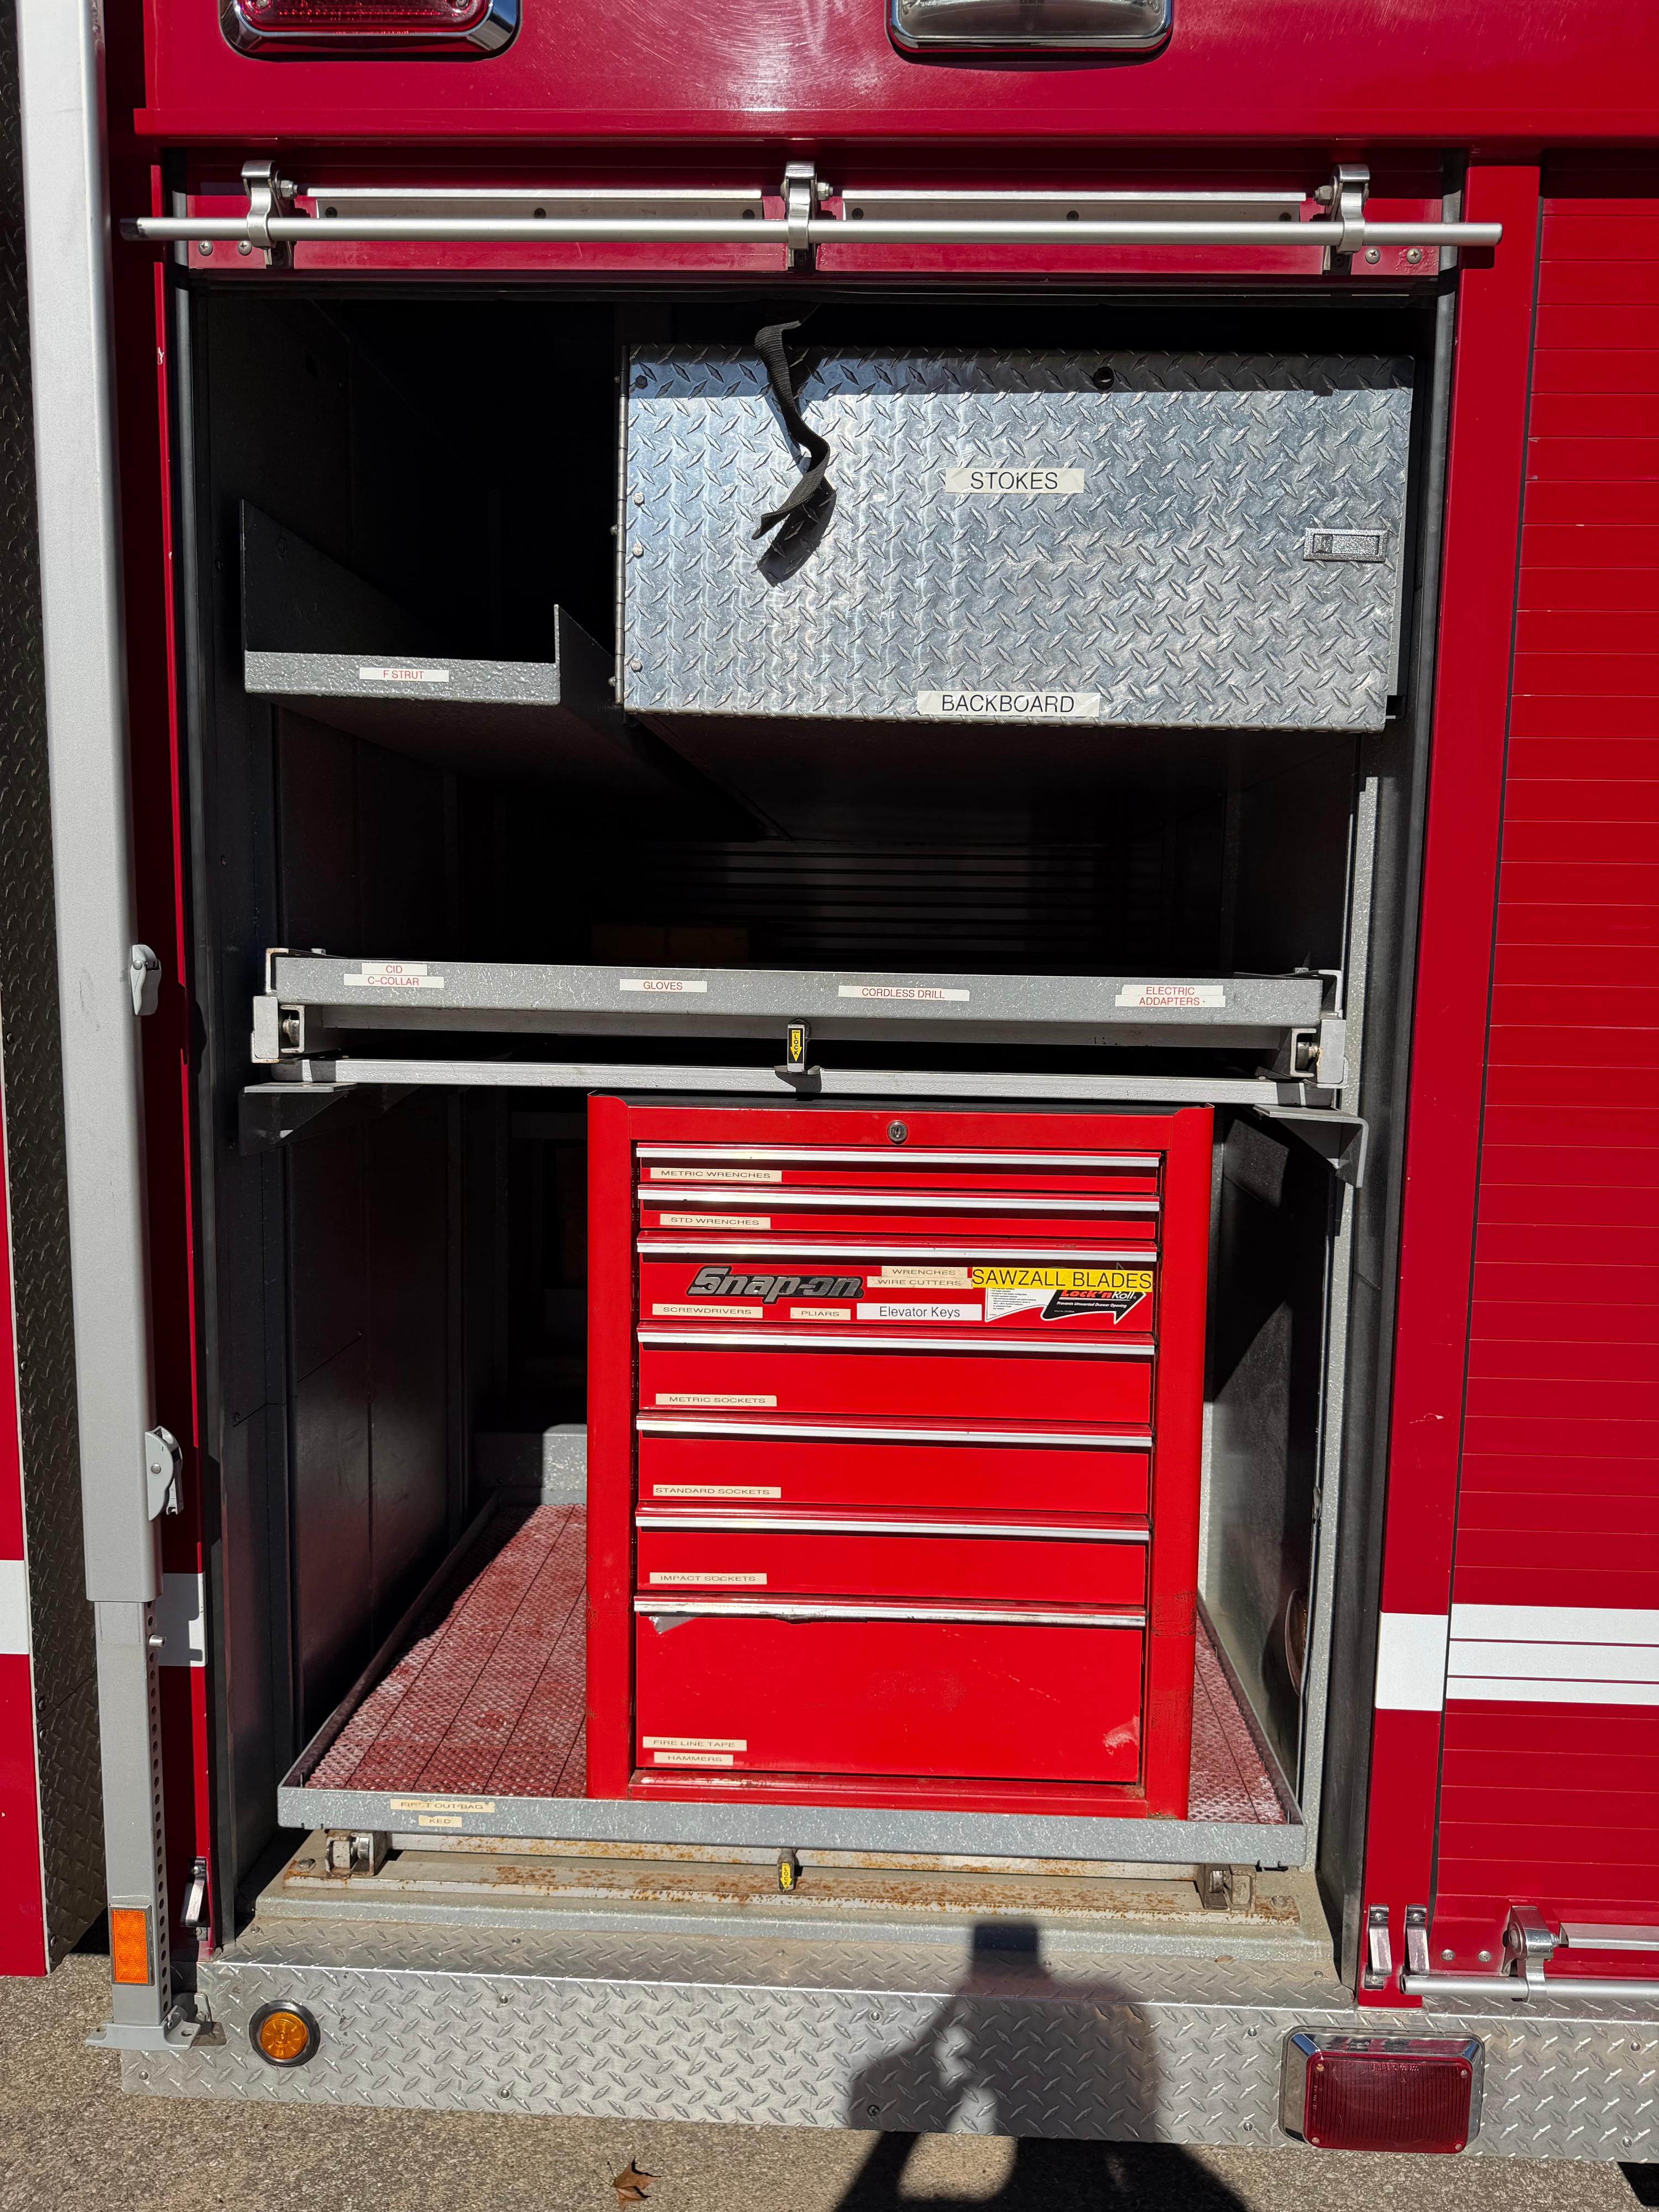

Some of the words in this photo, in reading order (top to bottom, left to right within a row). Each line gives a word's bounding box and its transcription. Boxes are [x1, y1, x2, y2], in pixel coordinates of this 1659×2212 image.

[971, 471, 1058, 489] STOKES
[383, 670, 389, 678] F
[392, 670, 424, 680] STRUT
[942, 695, 1074, 713] BACKBOARD
[386, 965, 403, 974] CID
[368, 976, 419, 986] C-COLLAR
[643, 981, 683, 990] GLOVES
[862, 988, 915, 998] CORDLESS
[918, 990, 945, 999] DRILL
[1146, 987, 1195, 995] ELECTRIC
[1139, 997, 1200, 1006] ADDAPTERS
[972, 1269, 1066, 1287] SAWZALL
[1072, 1271, 1152, 1289] BLADES
[688, 1267, 862, 1303] Snap-on
[880, 1306, 927, 1317] Elevator
[931, 1307, 960, 1318] Keys
